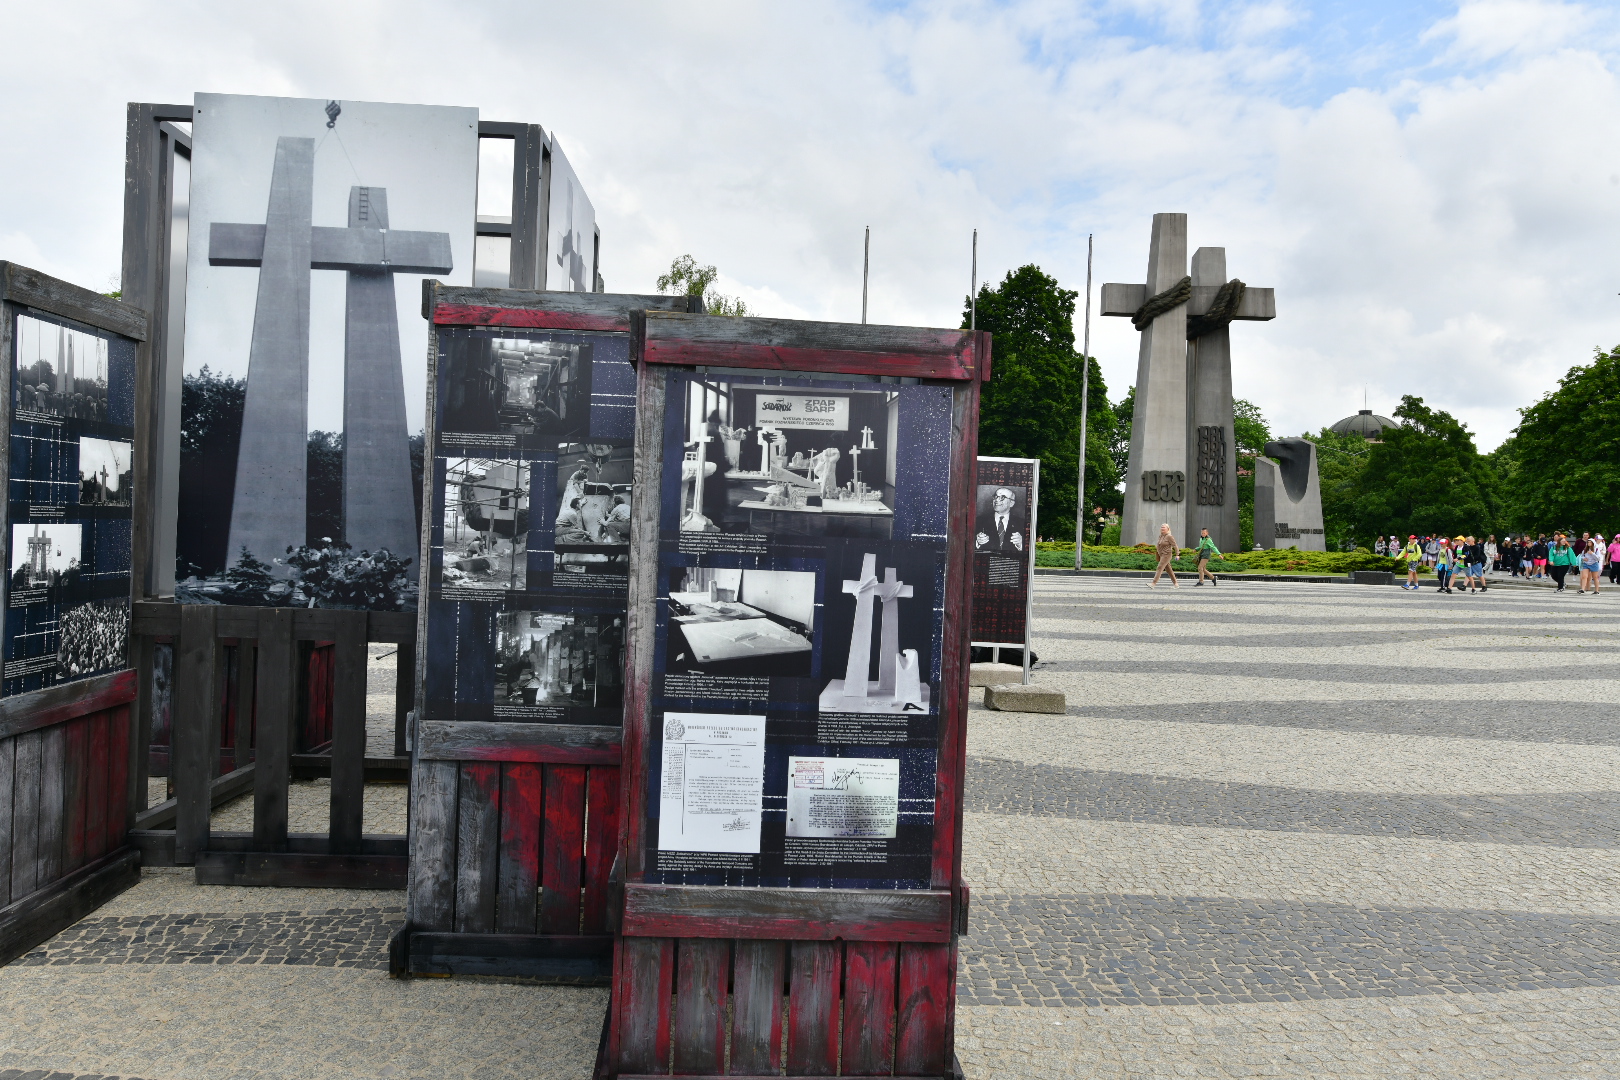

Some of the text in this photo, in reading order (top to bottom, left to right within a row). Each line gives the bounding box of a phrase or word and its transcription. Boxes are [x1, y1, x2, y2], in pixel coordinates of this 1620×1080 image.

[1198, 426, 1225, 442] 1981
[1198, 441, 1227, 458] 1980
[1197, 456, 1227, 472] 1976
[1141, 470, 1186, 503] 1956
[1197, 470, 1227, 487] 1970
[1196, 485, 1225, 506] 1968
[902, 702, 924, 711] A
